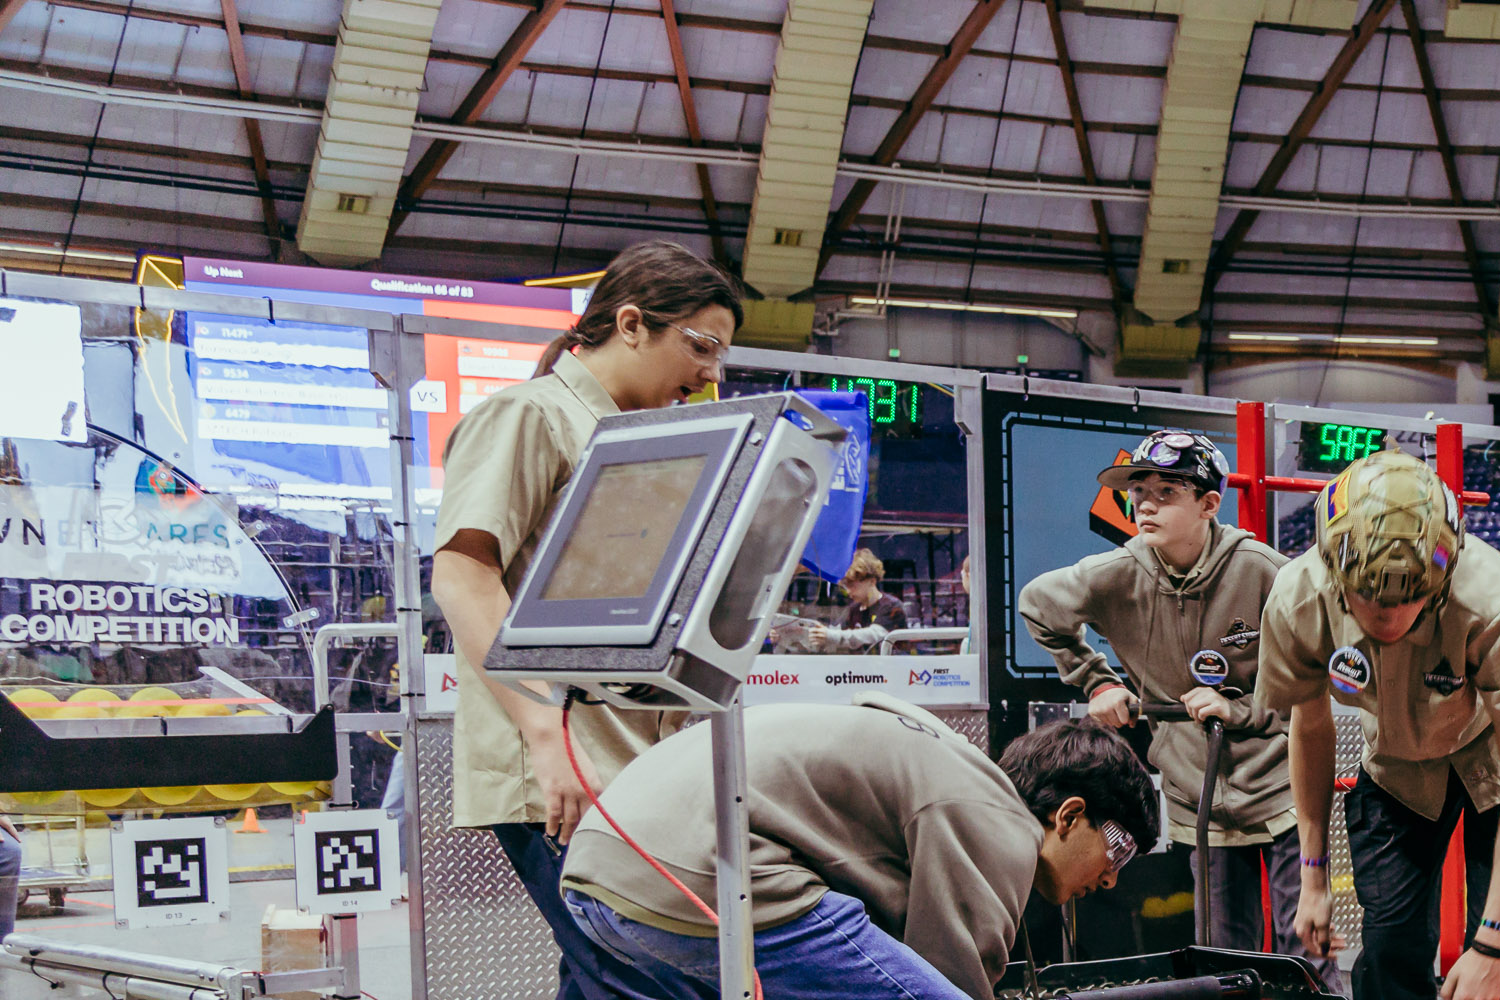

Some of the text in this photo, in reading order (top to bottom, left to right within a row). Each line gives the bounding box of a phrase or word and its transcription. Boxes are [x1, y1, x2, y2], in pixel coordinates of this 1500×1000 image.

[204, 265, 243, 279] Up Next
[371, 278, 433, 295] Qualification
[449, 284, 460, 296] of
[417, 391, 438, 404] VS
[30, 584, 209, 612] ROBOTICS
[1, 614, 239, 643] COMPETITION
[747, 670, 799, 685] molex
[825, 671, 888, 686] optimum.
